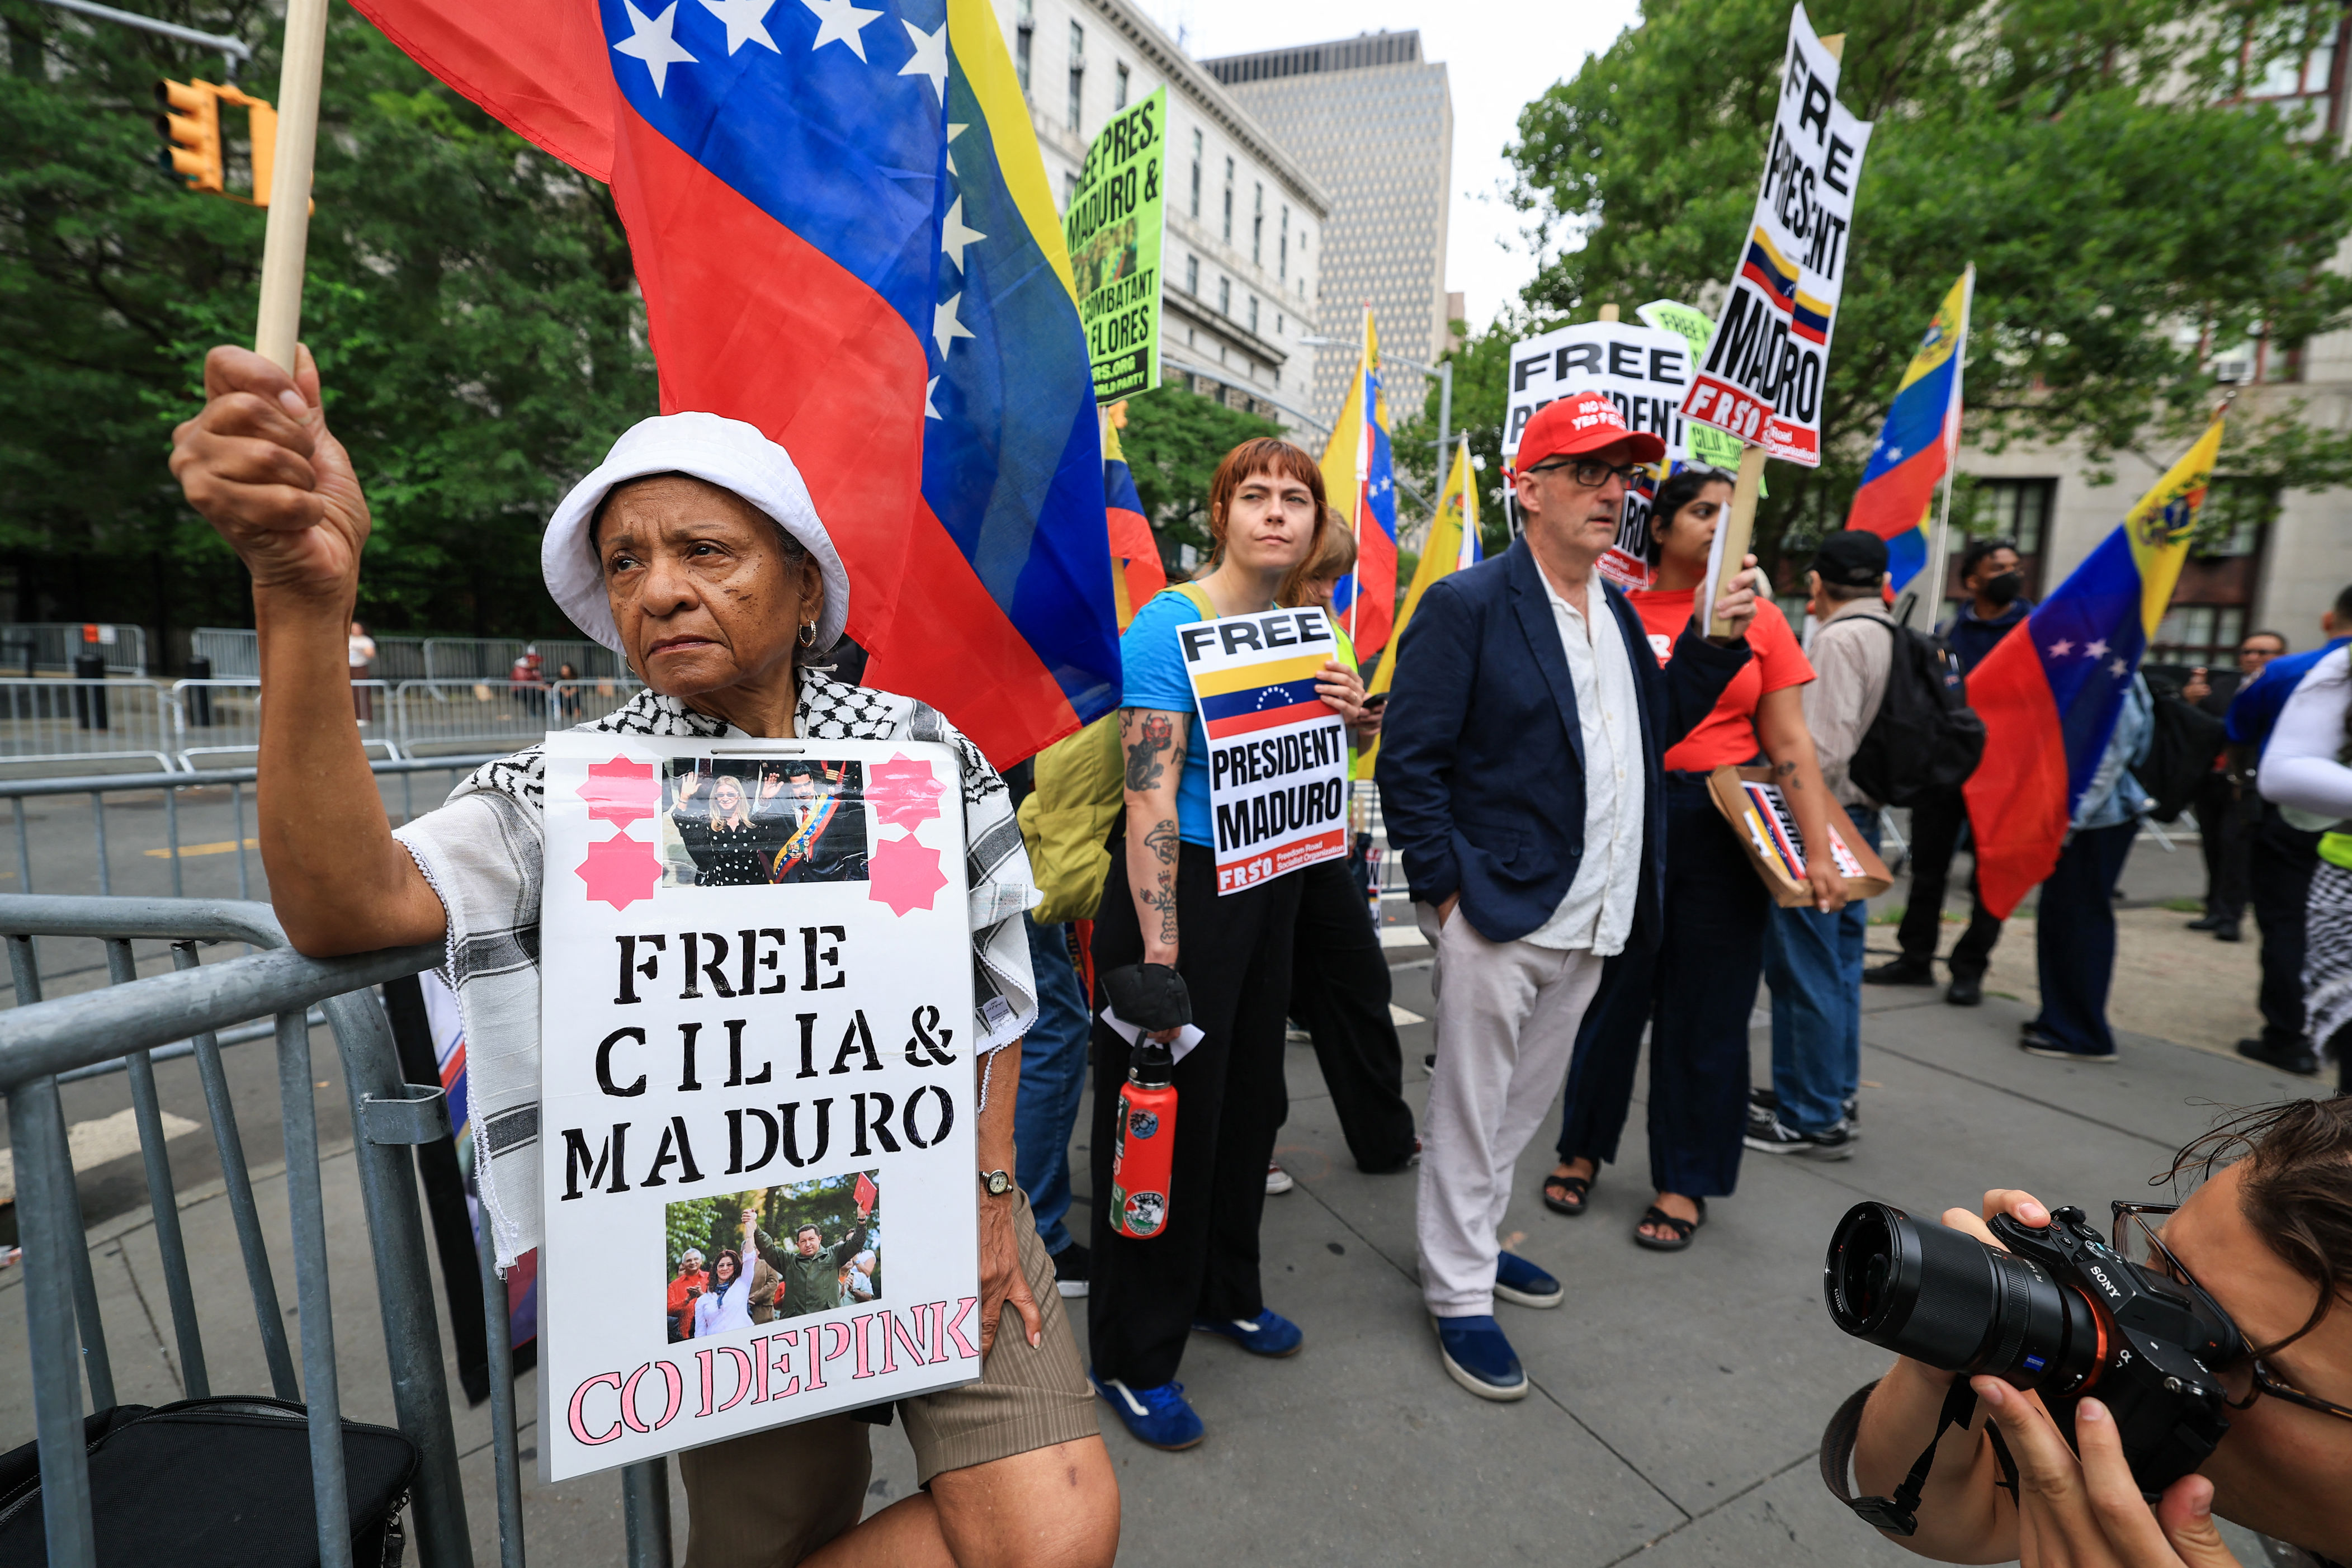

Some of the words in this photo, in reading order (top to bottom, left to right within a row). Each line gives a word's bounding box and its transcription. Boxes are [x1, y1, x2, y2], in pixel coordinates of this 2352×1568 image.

[1102, 100, 1159, 176] PRES.
[1786, 36, 1854, 197] FRE
[1068, 166, 1136, 253] MADURO
[1145, 158, 1158, 202] &
[1092, 304, 1148, 358] FLORES
[1706, 285, 1820, 424] MADRO
[1091, 355, 1136, 382] RS.ORG
[1117, 370, 1145, 393] PARTY
[1515, 342, 1685, 393] FREE
[1510, 390, 1682, 446] PDENT
[1571, 414, 1599, 431] YES
[1578, 400, 1599, 414] NO
[1687, 383, 1761, 438] FRSO
[1181, 613, 1331, 662] FREE
[1212, 725, 1342, 791] PRESIDENT
[1217, 777, 1342, 852] MADURO
[1218, 857, 1273, 891] FRSO
[1276, 846, 1305, 862] Freedom
[1306, 840, 1323, 852] Road
[1277, 856, 1303, 871] Socialist
[1303, 845, 1344, 862] Organization
[613, 925, 846, 1005] FREE
[595, 1009, 884, 1097] CILIA
[904, 1005, 957, 1068] &
[561, 1084, 955, 1202] MADURO
[2090, 1265, 2122, 1298] SONY
[568, 1296, 980, 1446] CODEPINK
